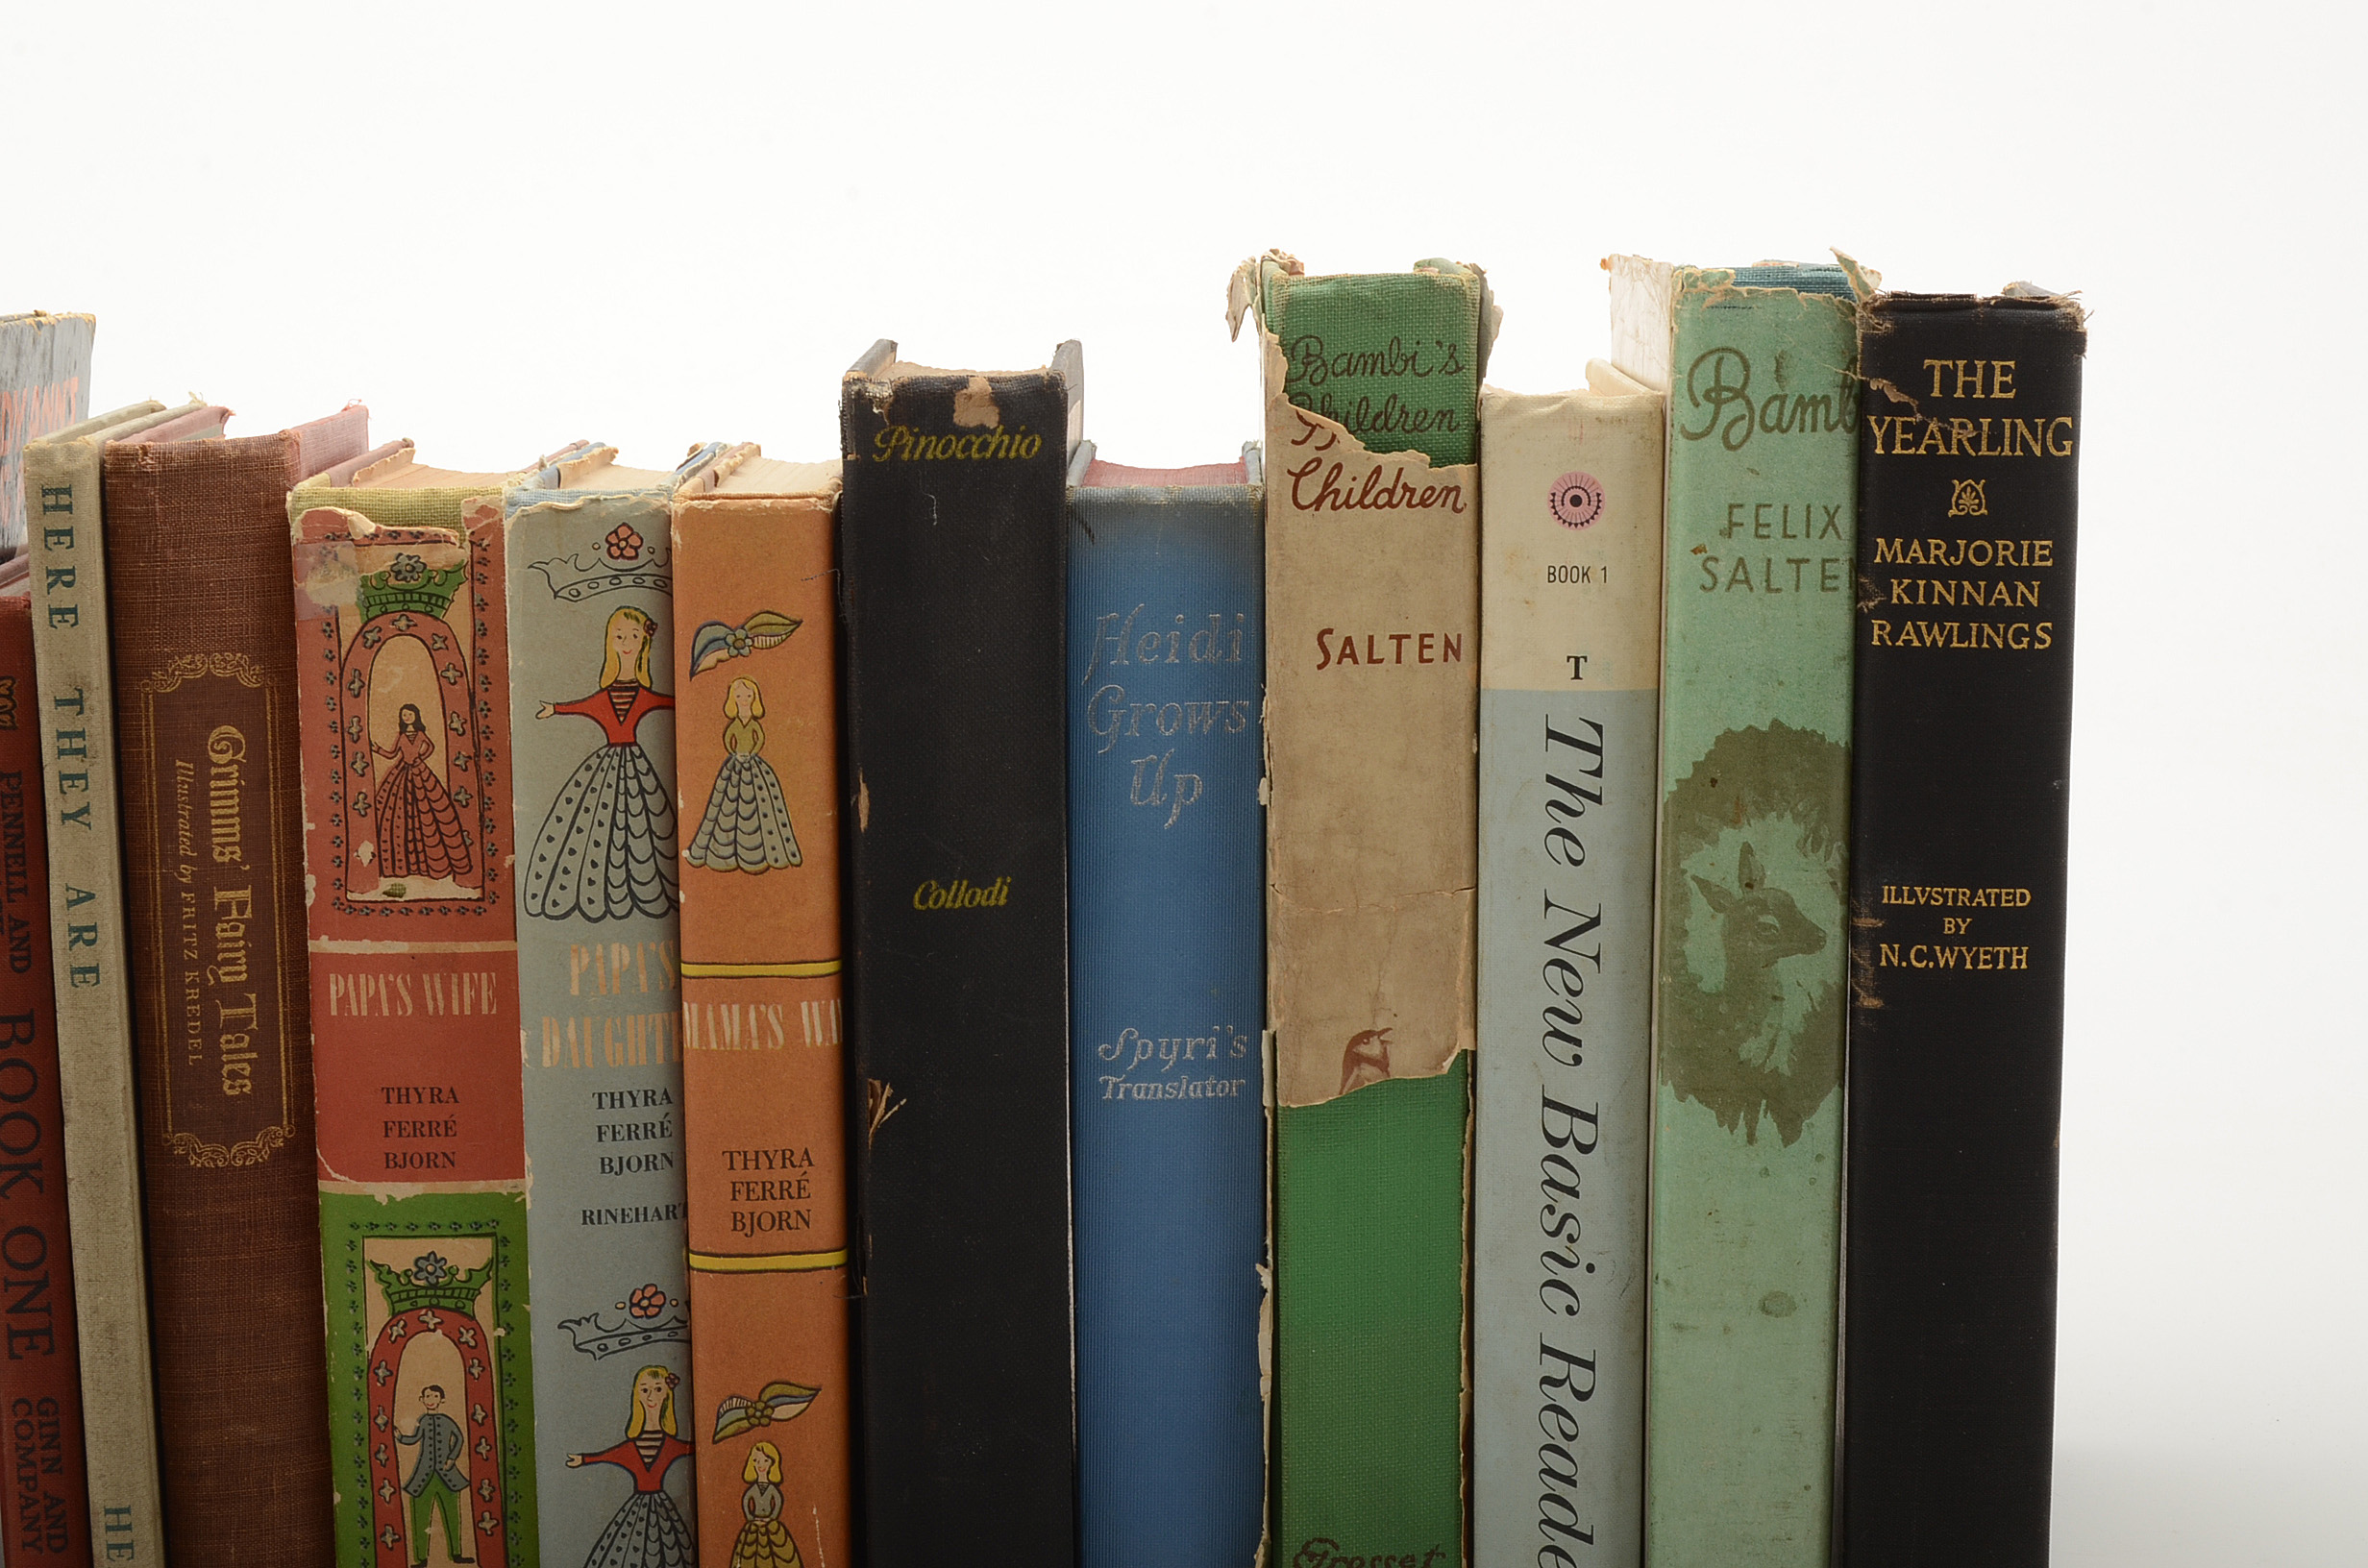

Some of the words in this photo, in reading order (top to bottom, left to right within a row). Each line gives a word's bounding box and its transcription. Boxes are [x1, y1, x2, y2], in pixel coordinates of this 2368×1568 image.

[1286, 335, 1466, 386] Bambi's
[1923, 358, 2017, 399] THE
[872, 424, 1043, 462] Pinocchio
[1866, 415, 2074, 457] YEARLING
[1286, 456, 1466, 514] Children
[1728, 502, 1843, 541] FELIX
[41, 482, 80, 630] HERE
[1547, 564, 1591, 584] BOOK
[1600, 565, 1608, 584] 1
[1873, 537, 2054, 567] MARJORIE
[1890, 578, 2041, 607] KINNAN
[1081, 603, 1246, 686] Heidi
[1317, 627, 1463, 671] SALTEN
[1871, 619, 2054, 649] RAWLINGS
[1566, 654, 1588, 680] T
[1087, 684, 1250, 754] Grows
[54, 686, 93, 832] THEY
[176, 759, 198, 857] Illustrated
[1130, 747, 1204, 830] Up
[1543, 713, 1603, 868] The
[0, 770, 29, 903] PENNELL
[174, 865, 198, 884] by
[912, 875, 1012, 911] Collodi
[1882, 885, 2033, 908] ILLVSTRATED
[9, 917, 33, 974] AND
[65, 882, 101, 990] ARE
[181, 891, 199, 961] FRITZ
[206, 884, 254, 987] Fairy
[1942, 917, 1973, 935] BY
[570, 938, 677, 996] PAPA'S
[1542, 888, 1602, 1067] New
[185, 969, 204, 1066] KREDEL
[329, 972, 414, 1017] PAPA'S
[422, 972, 498, 1017] WIFE
[215, 992, 259, 1096] Tales
[683, 1000, 785, 1051] MAMA'S
[800, 998, 843, 1048] WA
[1098, 1025, 1248, 1072] Spyri's
[0, 1009, 44, 1200] BOOK
[382, 1086, 460, 1105] THYRA
[592, 1087, 673, 1111] THYRA
[1098, 1073, 1246, 1101] Translator
[383, 1114, 457, 1139] FERRÉ
[596, 1112, 673, 1143] FERRÉ
[384, 1151, 456, 1169] BJORN
[600, 1152, 674, 1177] BJORN
[722, 1146, 815, 1171] THYRA
[730, 1170, 811, 1202] FERRÉ
[1539, 1084, 1599, 1317] Basic
[730, 1209, 812, 1238] BJORN
[1, 1224, 55, 1360] ONE
[37, 1396, 64, 1476] GINN
[12, 1397, 44, 1556] COMPANY
[43, 1491, 69, 1555] AND
[103, 1504, 136, 1562] HE
